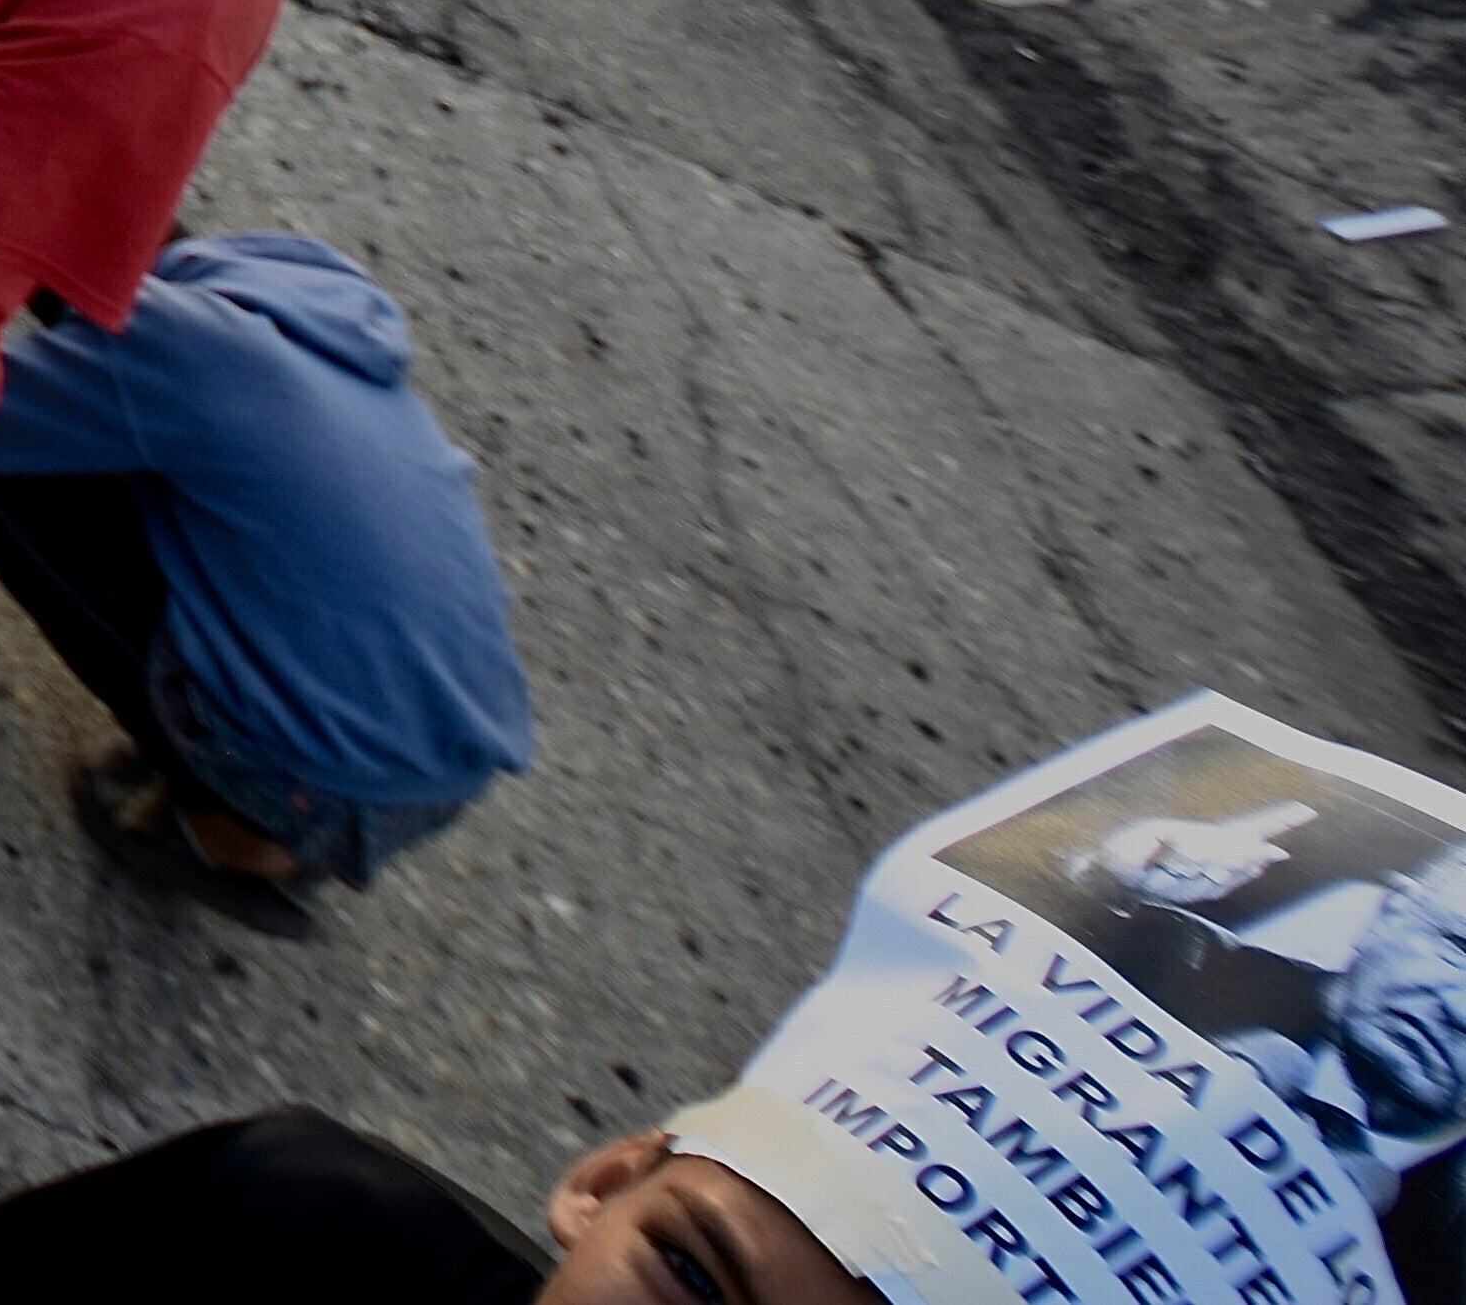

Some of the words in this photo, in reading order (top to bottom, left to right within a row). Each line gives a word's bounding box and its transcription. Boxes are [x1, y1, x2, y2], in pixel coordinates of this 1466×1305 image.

[803, 1077, 1083, 1305] IMPORT
[906, 1044, 1192, 1305] TAMBIE
[927, 891, 1016, 954] LA
[1037, 951, 1215, 1106] VIDA
[1223, 1114, 1335, 1225] DE
[1317, 1231, 1378, 1305] LO
[931, 972, 1295, 1305] MIGRANTE
